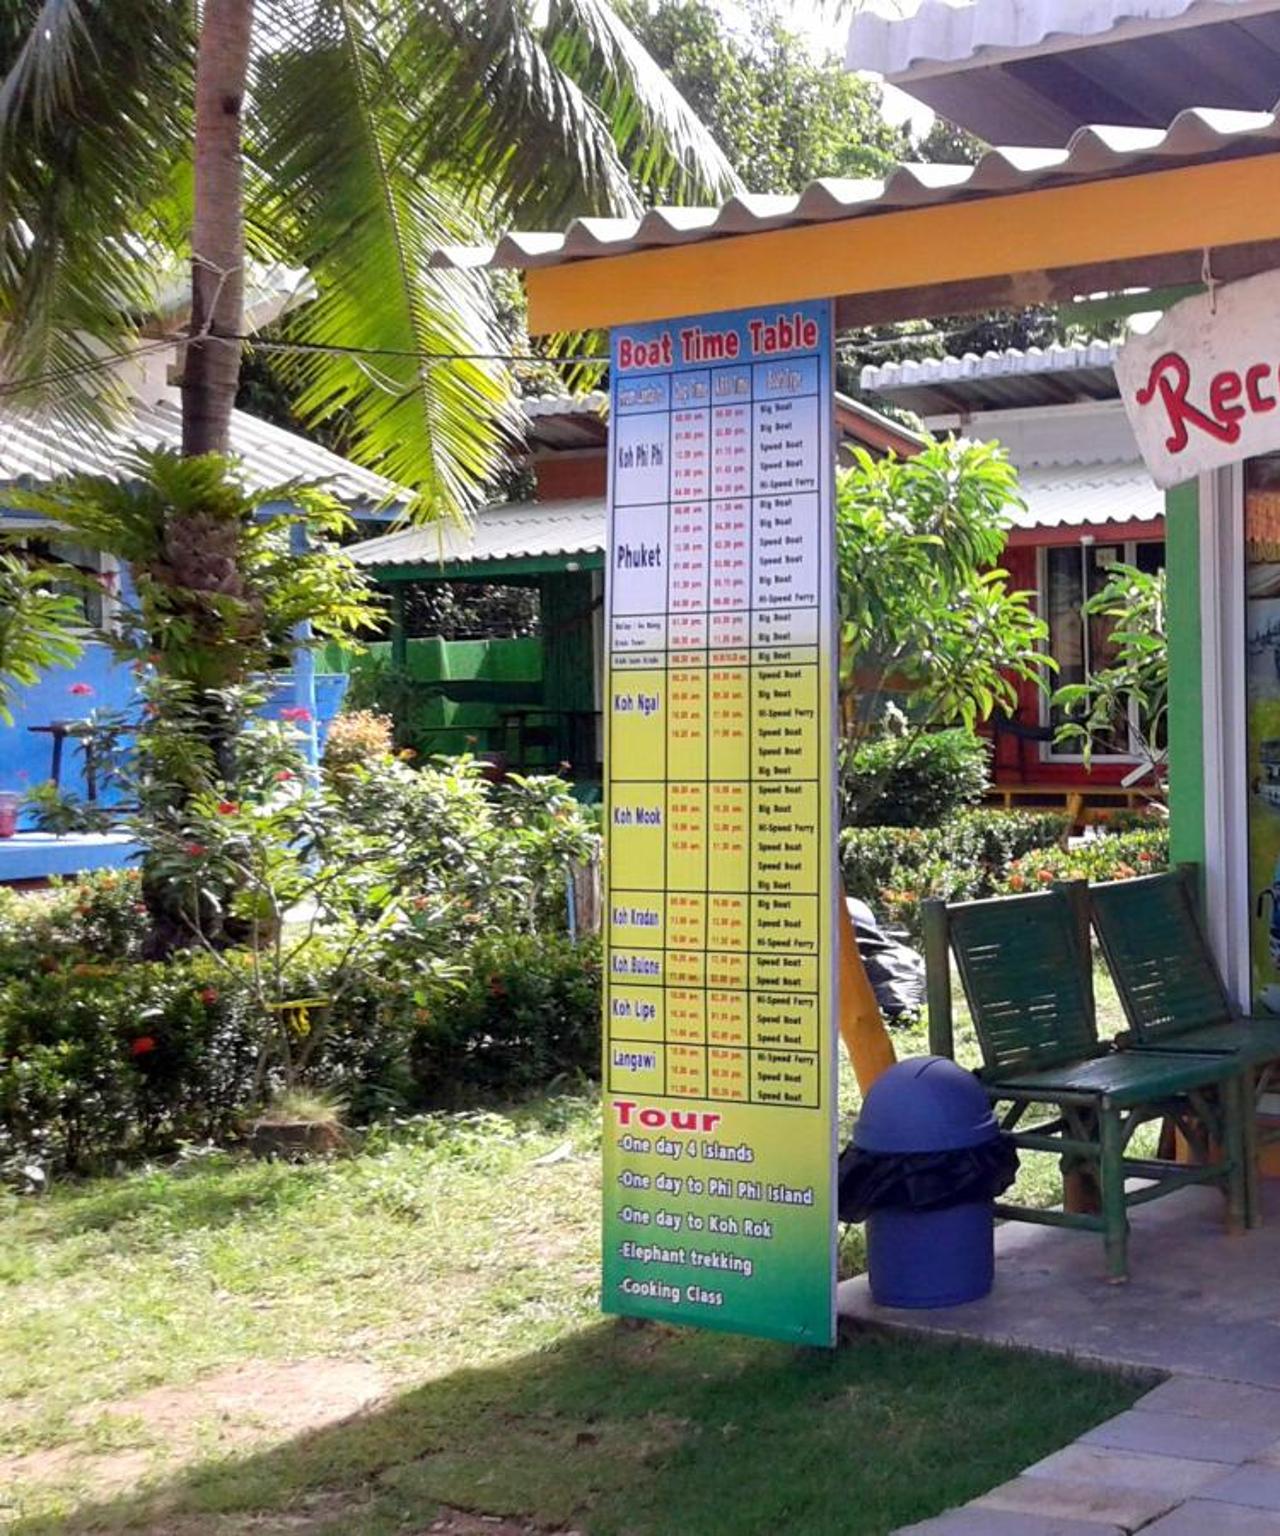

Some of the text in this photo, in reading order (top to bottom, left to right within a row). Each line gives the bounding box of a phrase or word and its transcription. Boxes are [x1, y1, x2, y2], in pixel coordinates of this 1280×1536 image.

[618, 316, 817, 370] Boat Time Table
[617, 543, 662, 569] Phuket
[614, 693, 659, 716] Koh Ngai
[614, 808, 661, 825] Koh Mook
[613, 999, 656, 1020] Koh Lipe
[614, 1051, 656, 1072] Langawi
[613, 1102, 720, 1132] Tour
[656, 1137, 682, 1158] day
[687, 1140, 696, 1156] 4
[702, 1141, 754, 1162] Islands
[656, 1172, 682, 1194] day
[688, 1178, 702, 1194] to
[708, 1179, 732, 1197] Phi
[738, 1181, 761, 1200] Phi
[768, 1185, 814, 1205] Island
[656, 1208, 682, 1231] day
[688, 1213, 702, 1230] to
[708, 1215, 738, 1234] Koh
[744, 1220, 772, 1238] Rok
[690, 1252, 753, 1276] trekking
[686, 1286, 723, 1306] Class
